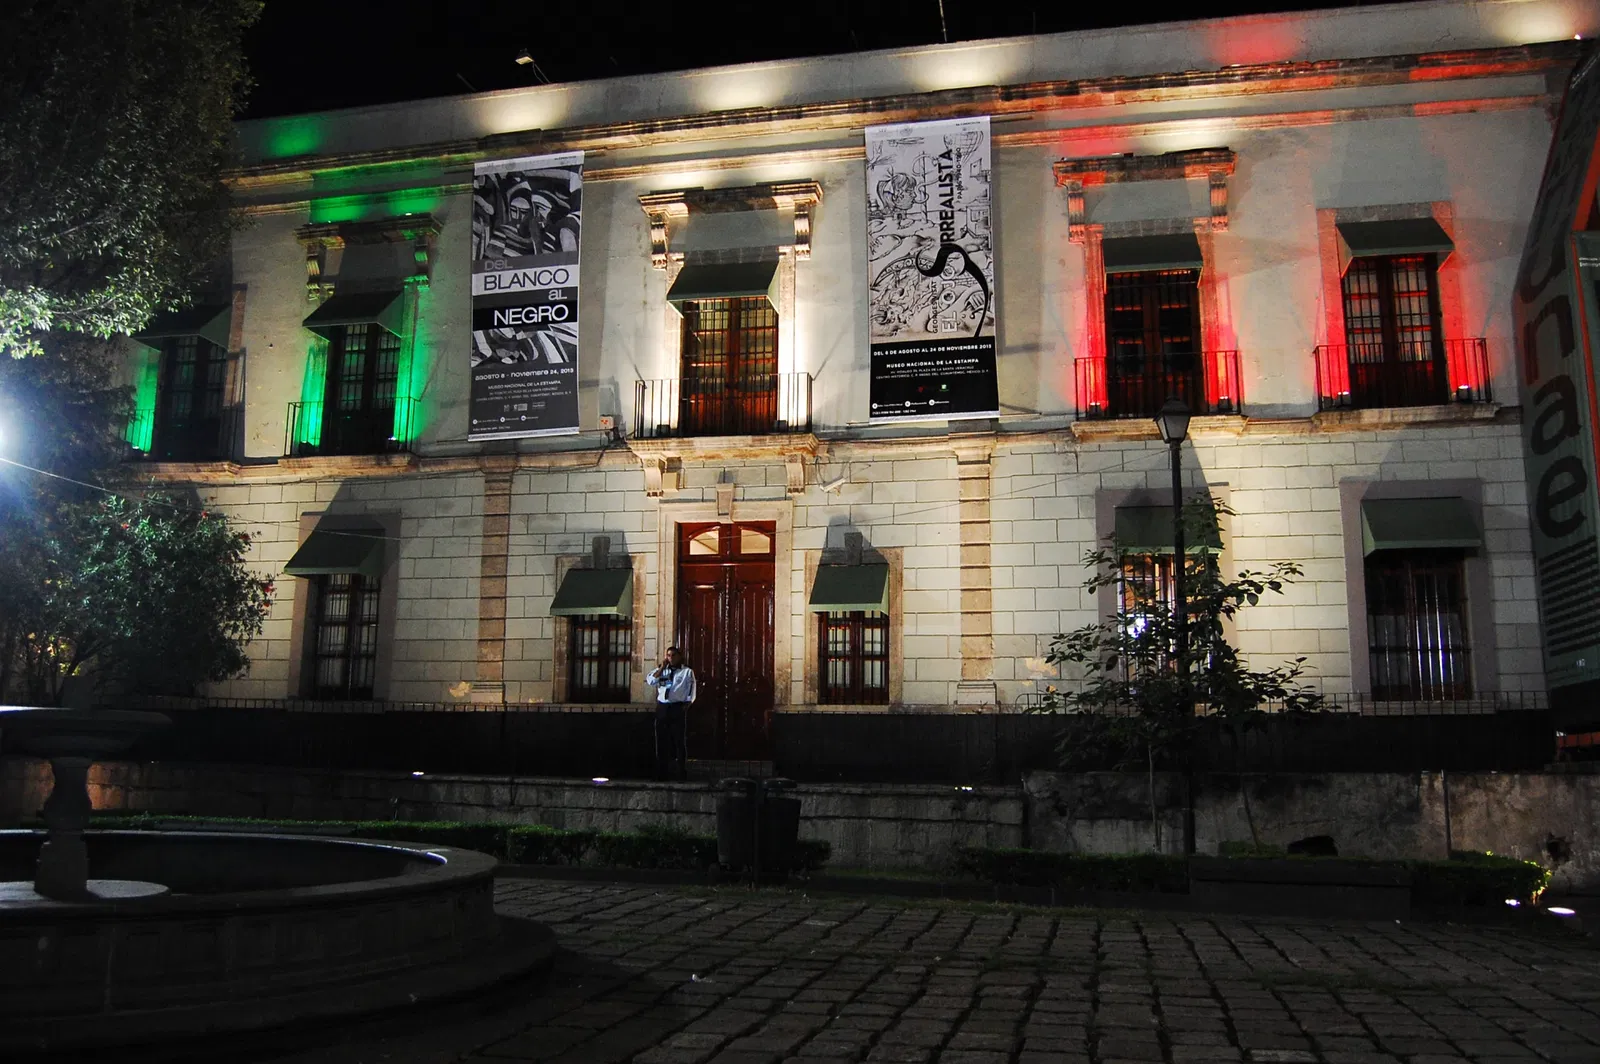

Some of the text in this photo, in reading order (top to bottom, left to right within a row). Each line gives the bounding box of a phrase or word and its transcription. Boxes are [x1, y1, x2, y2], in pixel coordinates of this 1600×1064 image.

[484, 268, 570, 291] BLANCO
[494, 304, 569, 326] NEGRO
[940, 311, 959, 333] EL
